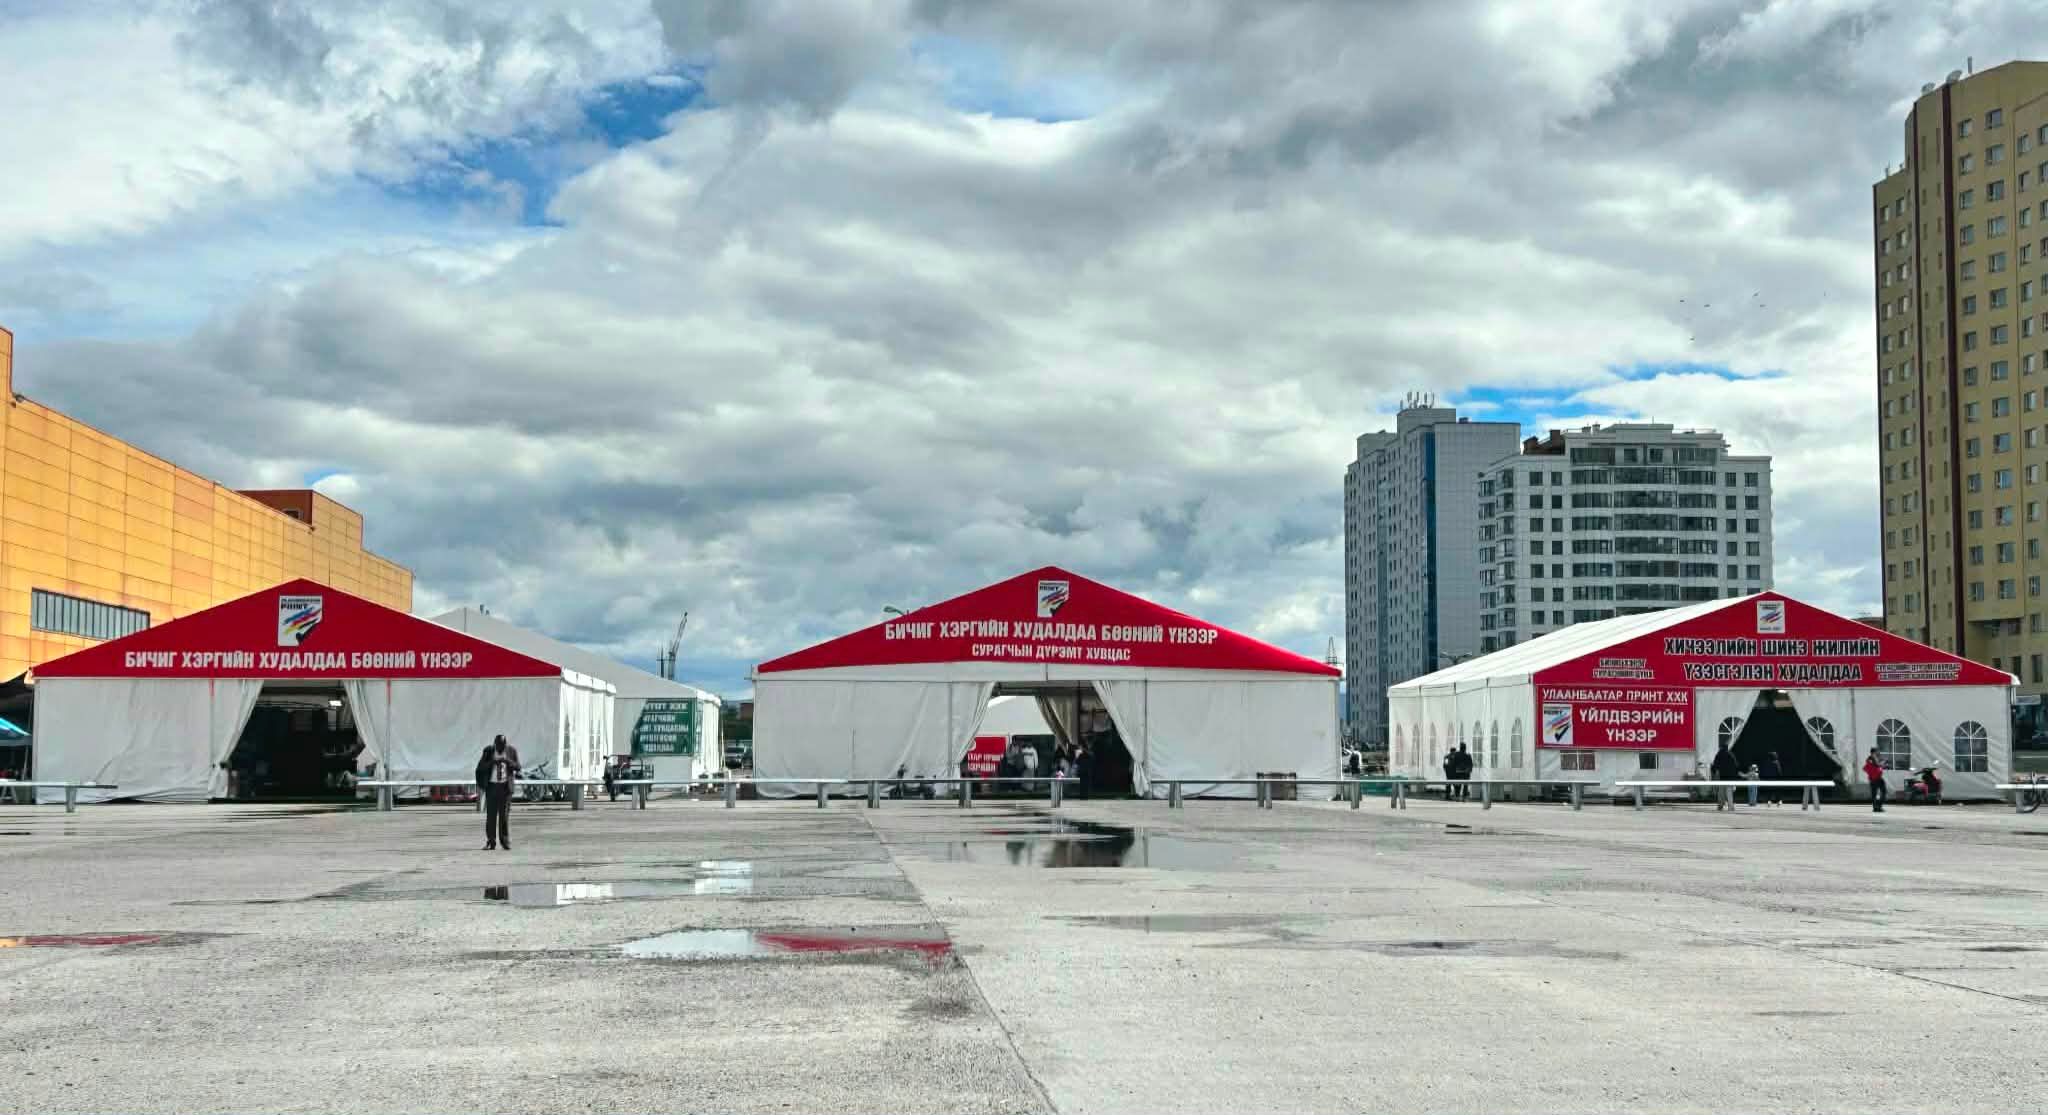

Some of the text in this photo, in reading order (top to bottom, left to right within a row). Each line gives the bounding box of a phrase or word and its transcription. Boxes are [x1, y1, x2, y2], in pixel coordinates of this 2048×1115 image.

[885, 620, 1218, 644] БИЧИГ ХЭРГИЙН ХУДАЛДАА БӨӨНИЙ ҮНЭЭР
[973, 644, 1130, 661] СУРАГЧЫН ДҮРЭМТ ХУВЦАС
[1664, 637, 1880, 656] ХИЧЭЭЛИЙН ШИНЭ ЖИЛИЙН
[126, 651, 472, 670] БИЧИГ ХЭРГИЙН ХУДАЛДАА БӨӨНИЙ ҮНЭЭР
[1684, 663, 1774, 680] ҮЗЭСГЭЛЭН
[1778, 664, 1861, 682] ХУДАЛДАА
[1544, 689, 1687, 704] УЛААНБААТАР ПРИНТ ХХК
[1580, 708, 1683, 724] ҮЙЛДВЭРИЙН
[1607, 729, 1656, 741] ҮНЭЭР
